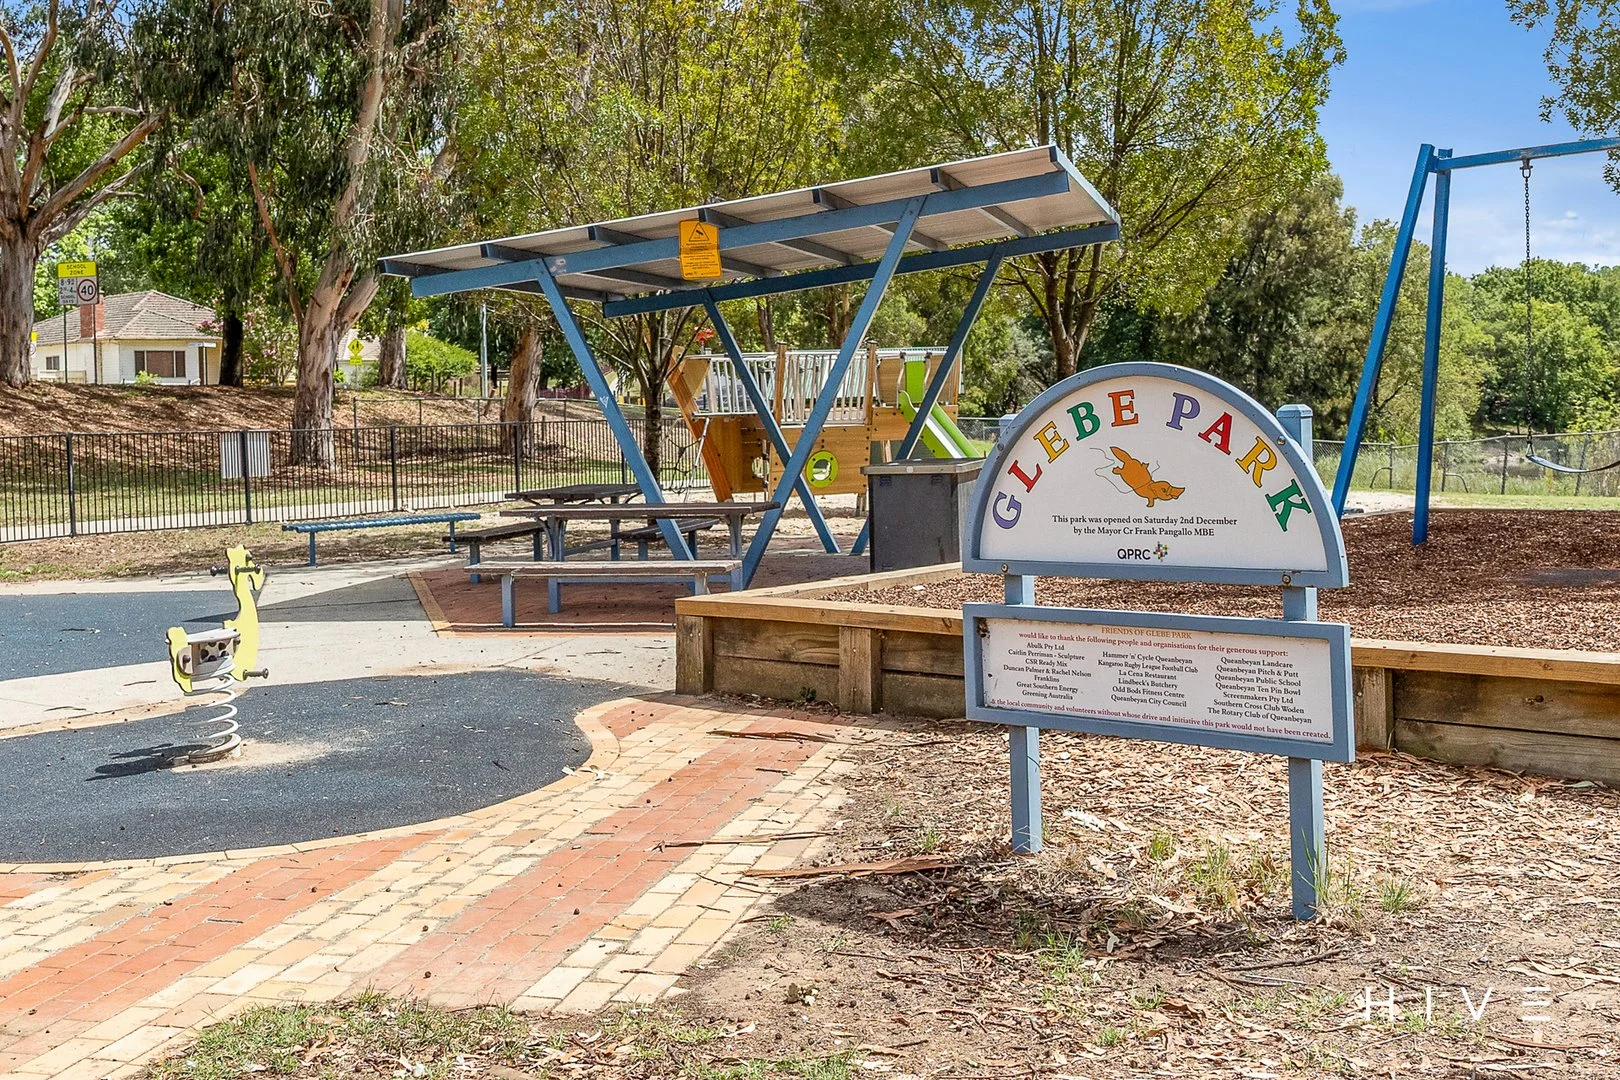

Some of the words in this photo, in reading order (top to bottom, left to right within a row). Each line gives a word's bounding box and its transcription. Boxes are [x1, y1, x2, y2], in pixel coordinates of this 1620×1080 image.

[81, 285, 93, 295] 40
[992, 389, 1139, 529] GLEBE
[1166, 392, 1312, 532] PARK
[1070, 516, 1087, 526] park
[1104, 516, 1131, 526] opened
[1144, 516, 1178, 526] Saturday
[1196, 517, 1237, 525] December
[1073, 527, 1082, 535] by
[1097, 527, 1121, 536] Mayor
[1135, 527, 1157, 535] Frank
[1159, 528, 1192, 537] Pangallo
[1117, 549, 1151, 560] QPRC
[1102, 627, 1132, 636] FRIENDS
[1087, 636, 1116, 646] following
[1118, 639, 1138, 648] people
[1153, 641, 1196, 650] organisations
[1226, 647, 1257, 655] generous
[1259, 649, 1288, 658] support:
[1058, 652, 1085, 661] Sculpture
[1138, 654, 1154, 662] Cycle
[1155, 656, 1192, 664] Queanbeyan
[1039, 659, 1055, 668] Ready
[1098, 660, 1122, 669] Kangaroo
[1124, 662, 1140, 670] Rugby
[1142, 662, 1160, 672] League
[1162, 664, 1184, 672] Football
[1221, 657, 1261, 666] Queanbeyan
[1262, 660, 1293, 668] Landcare
[1145, 672, 1177, 680] Restaurant
[1216, 665, 1256, 675] Queanbeyan
[1258, 668, 1275, 676] Pitch
[1118, 678, 1150, 686] Lindbeck's
[1151, 680, 1178, 690] Butchery
[1215, 674, 1254, 683] Queanbeyan
[1256, 676, 1277, 685] Public
[1278, 678, 1301, 686] School
[1033, 682, 1058, 690] Southern
[1059, 684, 1078, 693] Energy
[1142, 688, 1162, 696] Fitness
[1164, 690, 1184, 698] Centre
[1216, 682, 1255, 692] Queanbeyan
[1284, 687, 1301, 696] Bowl
[1022, 690, 1047, 699] Greening
[1048, 692, 1073, 700] Australia
[1111, 694, 1147, 703] Queanbeyan
[1149, 697, 1161, 706] City
[1163, 699, 1187, 707] Council
[1223, 691, 1267, 701] Screenmakers
[1269, 696, 1280, 704] Pty
[1214, 699, 1242, 708] Southern
[1244, 702, 1262, 710] Cross
[1264, 704, 1280, 712] Club
[1282, 705, 1304, 714] Woden
[1007, 699, 1020, 707] local
[1021, 701, 1053, 711] community
[1066, 704, 1096, 714] volunteers
[1097, 707, 1120, 717] without
[1122, 710, 1140, 719] whose
[1142, 712, 1158, 721] drive
[1159, 714, 1171, 722] and
[1172, 716, 1200, 725] initiative
[1215, 720, 1230, 729] park
[1232, 721, 1252, 730] would
[1267, 725, 1282, 734] have
[1284, 727, 1300, 736] been
[1303, 729, 1330, 739] created.
[1222, 708, 1243, 718] Rotary
[1245, 711, 1260, 719] Club
[1270, 714, 1312, 724] Queanbeyan
